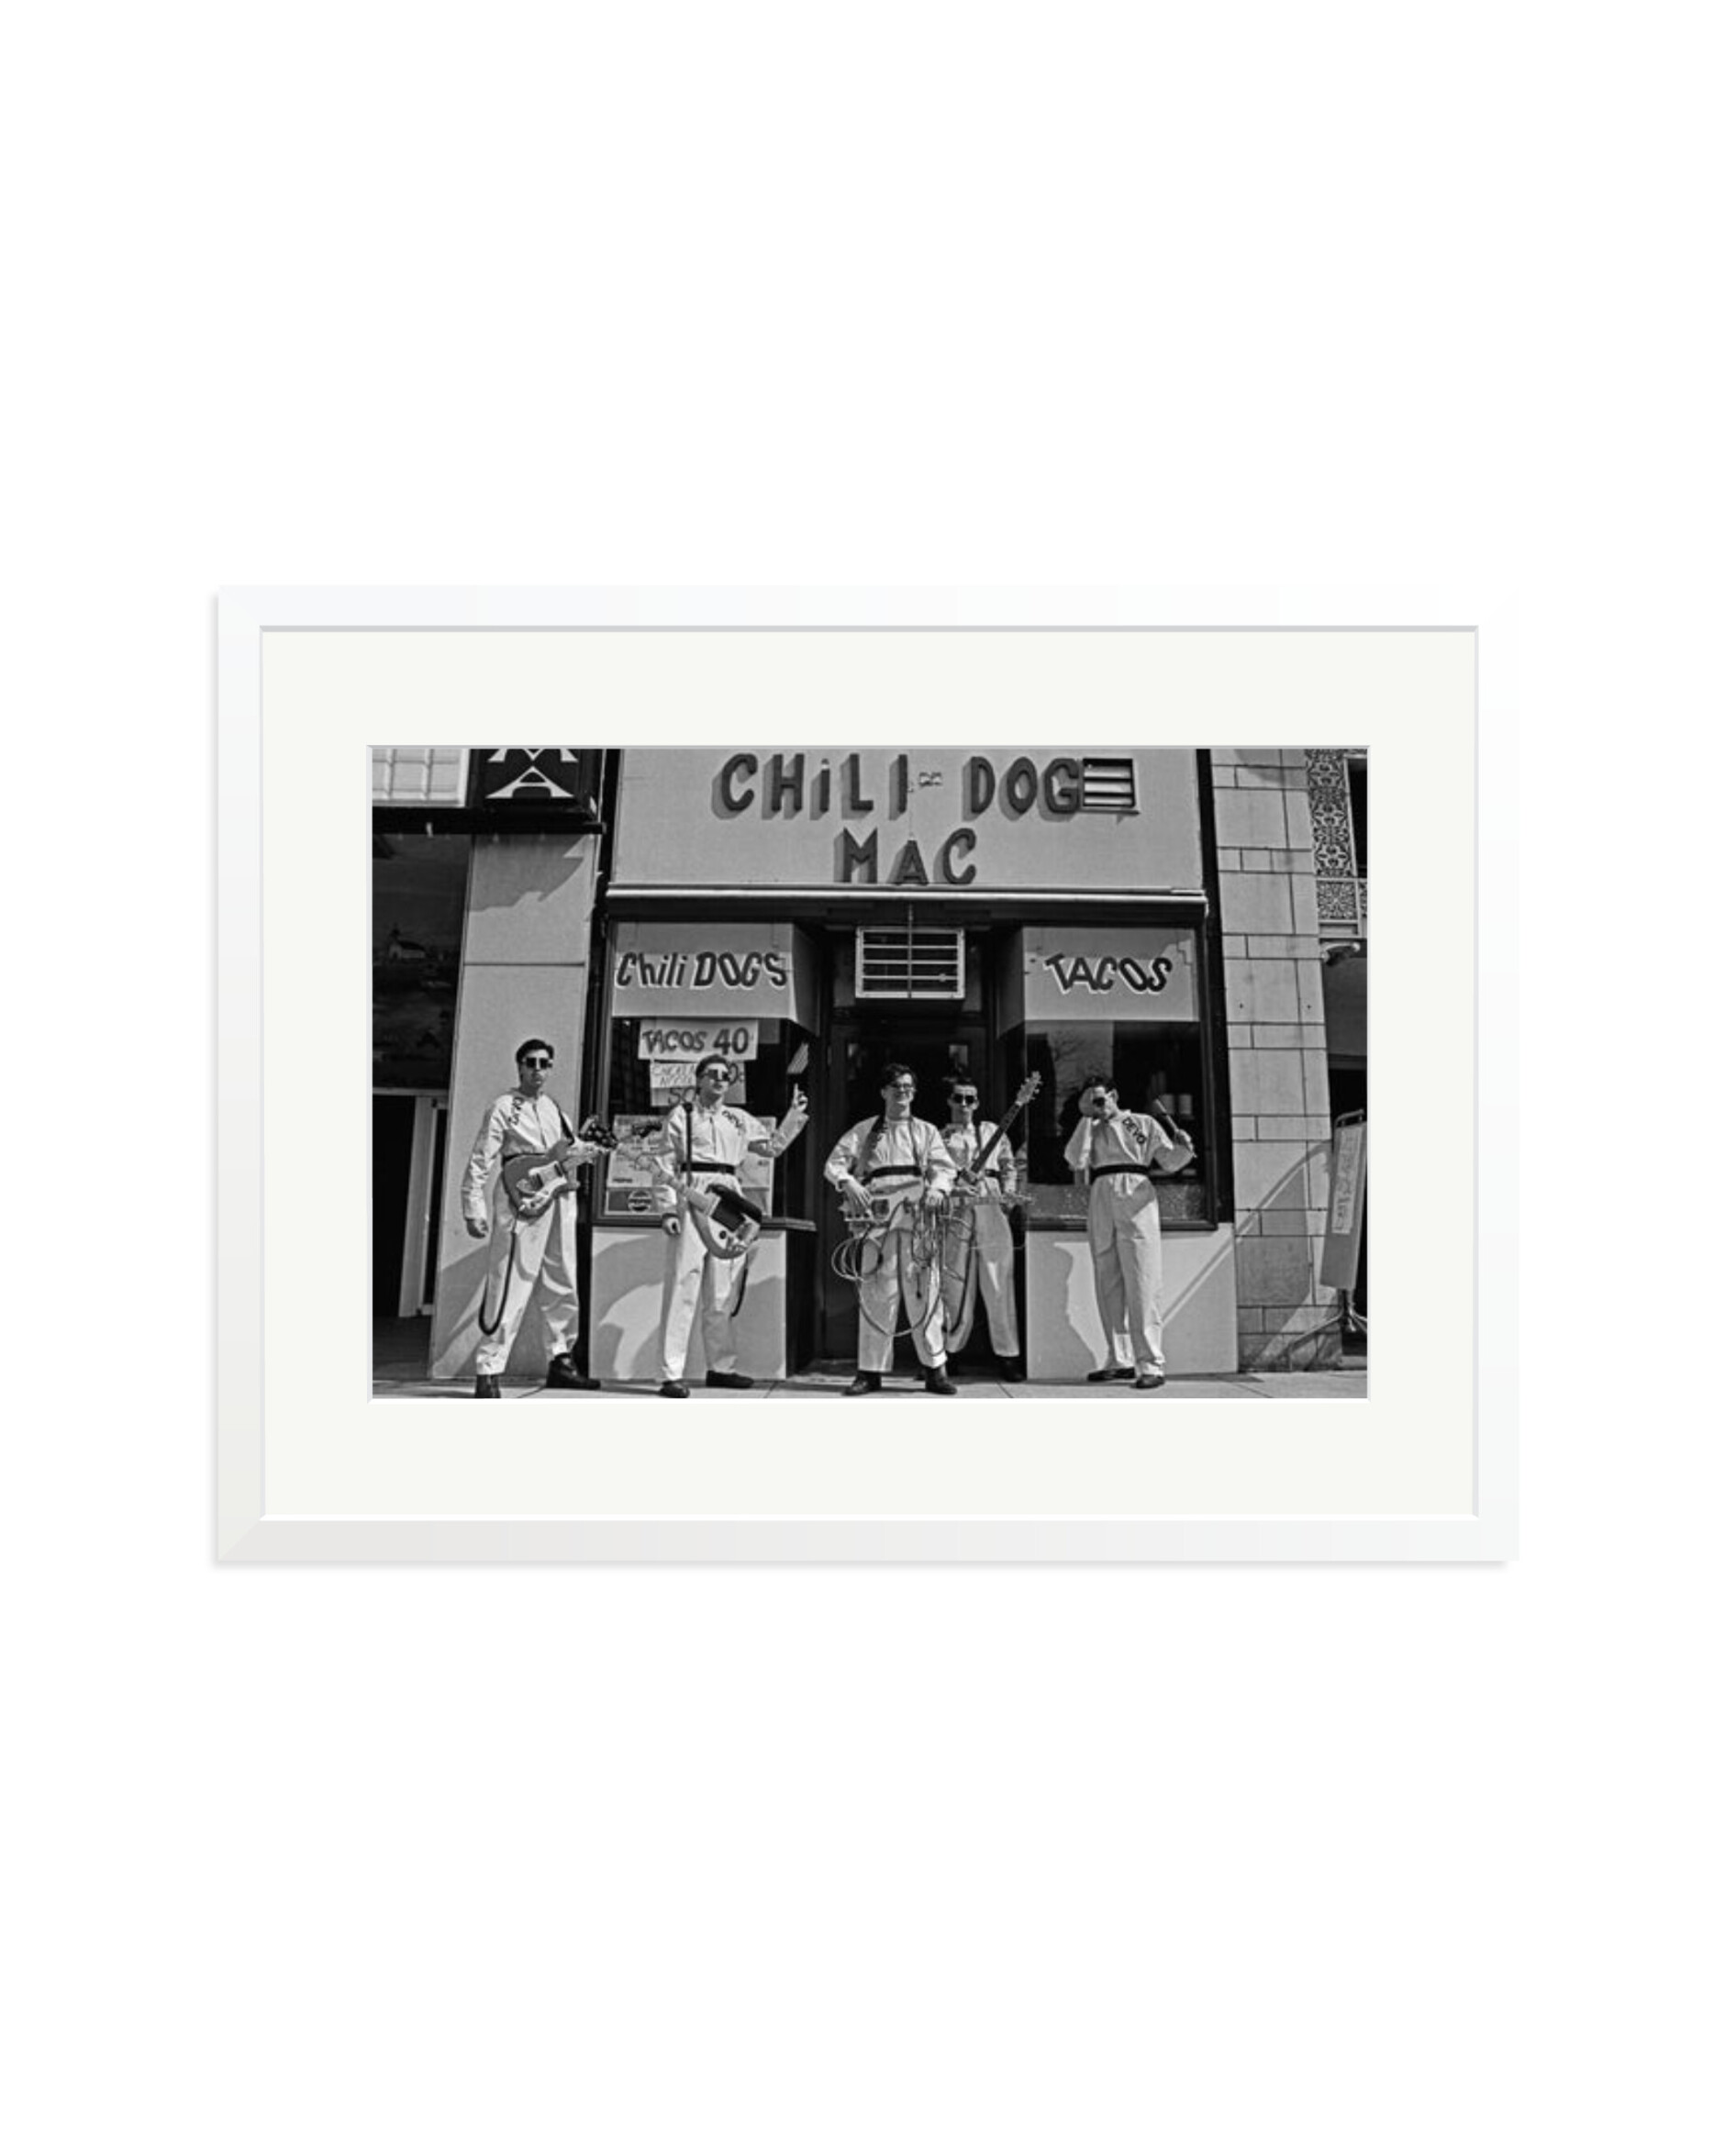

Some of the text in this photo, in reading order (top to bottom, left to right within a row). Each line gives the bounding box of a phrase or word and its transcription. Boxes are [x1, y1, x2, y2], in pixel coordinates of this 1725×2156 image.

[967, 756, 1080, 816] DOG
[840, 827, 977, 886] MAC
[617, 951, 787, 987] Chili DOGS
[1044, 952, 1173, 993] TACOS
[642, 1027, 750, 1055] TACOS 40
[1121, 1117, 1147, 1145] DEVO
